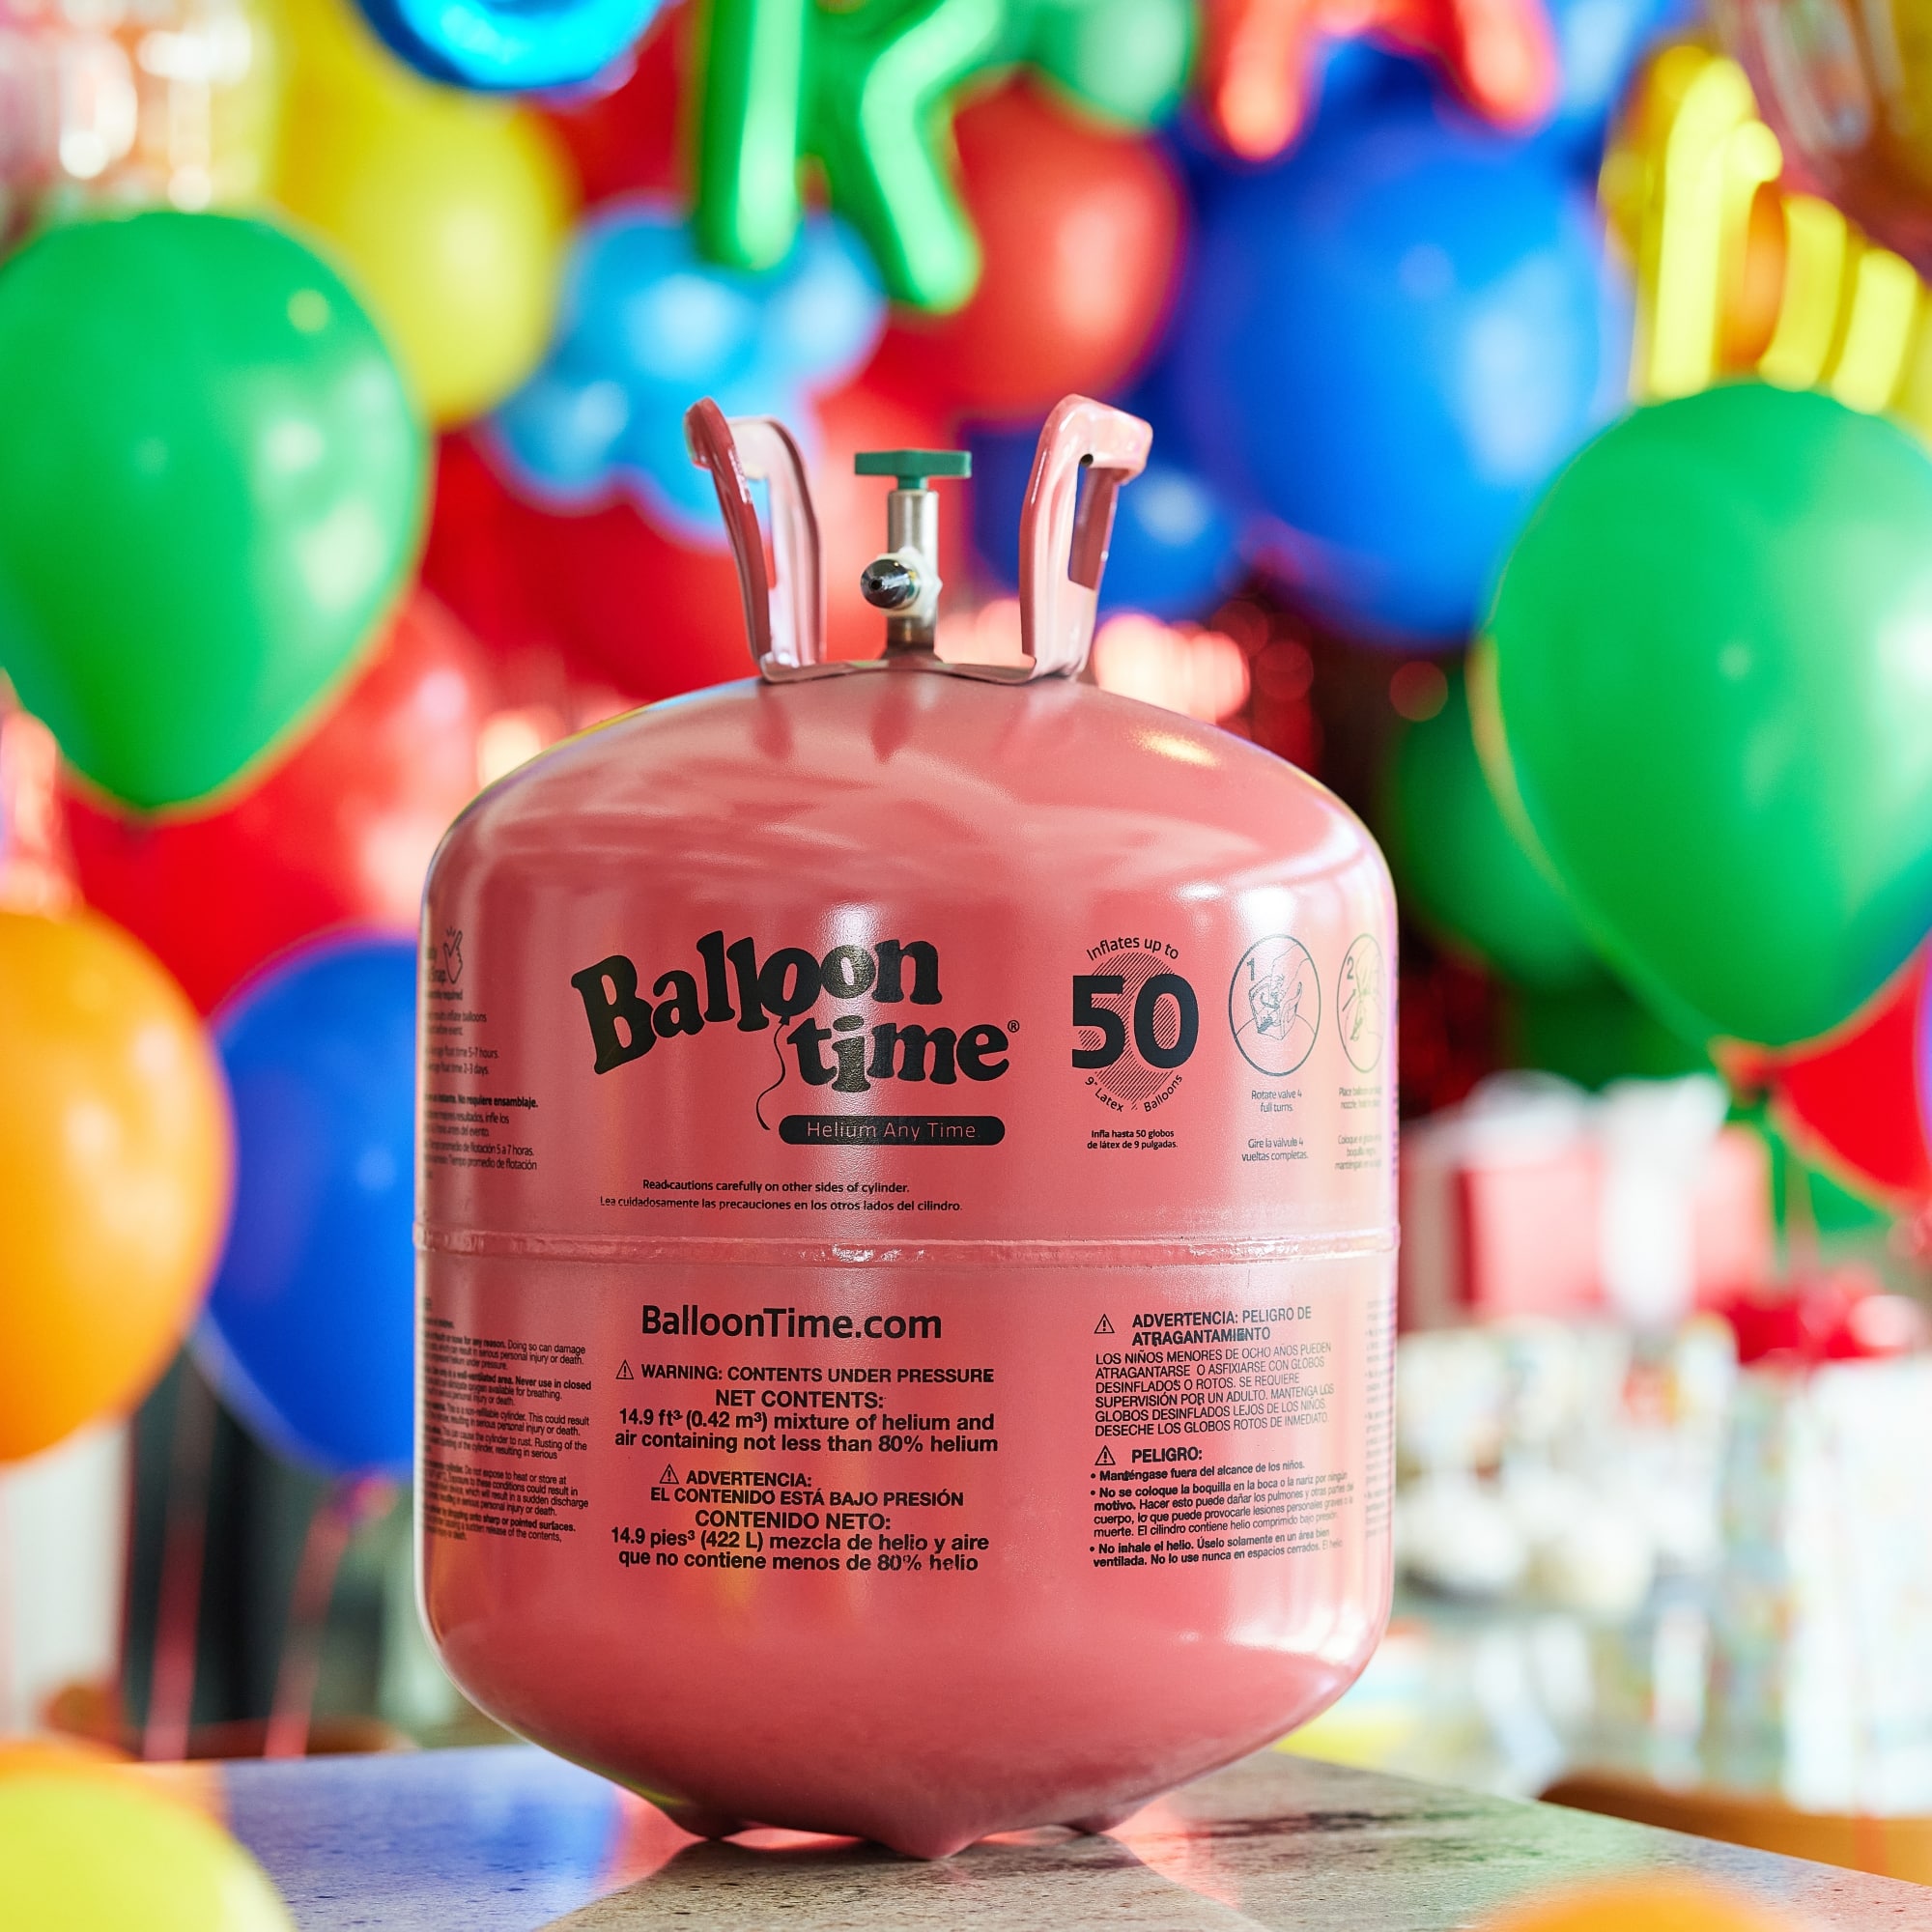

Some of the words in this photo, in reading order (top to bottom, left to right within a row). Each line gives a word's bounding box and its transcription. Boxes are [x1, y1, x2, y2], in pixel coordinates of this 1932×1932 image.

[1086, 937, 1140, 961] Inflates
[1144, 938, 1162, 952] up
[1164, 944, 1179, 959] to
[571, 930, 943, 1075] Balloon
[1071, 974, 1200, 1070] 50
[1094, 1088, 1123, 1112] Latex
[1144, 1074, 1182, 1112] Balloons
[1252, 1091, 1276, 1099] Rotate
[1278, 1090, 1296, 1098] valve
[808, 1122, 876, 1137] Helium
[884, 1122, 920, 1141] Any
[1092, 1129, 1110, 1138] Infla
[1112, 1129, 1134, 1138] hasta
[1136, 1129, 1147, 1138] 50
[1149, 1129, 1175, 1139] globos
[1099, 1140, 1121, 1149] látex
[1122, 1140, 1132, 1149] de
[1134, 1140, 1140, 1149] 9
[1141, 1140, 1178, 1150] pulgadas.
[716, 1181, 763, 1194] carefully
[764, 1183, 780, 1192] on
[781, 1181, 813, 1192] other
[815, 1182, 843, 1192] sides
[846, 1182, 859, 1192] of
[862, 1182, 910, 1194] cylinder.
[600, 1196, 615, 1206] Lea
[617, 1196, 699, 1208] cuidadosamente
[701, 1198, 716, 1208] las
[719, 1199, 791, 1210] precauciones
[810, 1199, 827, 1209] los
[830, 1202, 860, 1210] otros
[863, 1200, 894, 1210] lados
[896, 1200, 914, 1210] del
[917, 1200, 962, 1210] cilindro.
[642, 1304, 941, 1339] BalloonTime.com
[1132, 1311, 1237, 1327] ADVERTENCIA:
[1242, 1307, 1293, 1322] PELIGRO
[1297, 1306, 1311, 1320] DE
[1131, 1326, 1270, 1347] ATRAGANTAMIENTO
[1095, 1352, 1122, 1364] LOS
[1124, 1350, 1163, 1364] NIÑOS
[1167, 1349, 1222, 1362] MENORES
[1225, 1348, 1238, 1359] DE
[1241, 1347, 1270, 1358] OCHO
[640, 1363, 722, 1379] WARNING:
[727, 1366, 822, 1382] CONTENTS
[828, 1368, 891, 1382] UNDER
[897, 1368, 994, 1382] PRESSURE
[1095, 1379, 1180, 1393] DESINFLADOS
[1183, 1378, 1192, 1390] O
[1196, 1377, 1236, 1389] ROTOS.
[1239, 1376, 1252, 1387] SE
[1255, 1372, 1299, 1386] REQUIERE
[716, 1389, 755, 1406] NET
[761, 1390, 886, 1408] CONTENTS:
[619, 1407, 653, 1425] 14.9
[686, 1409, 729, 1431] (0.42
[774, 1412, 849, 1430] mixture
[856, 1413, 877, 1430] of
[882, 1413, 950, 1431] helium
[956, 1413, 994, 1430] and
[614, 1430, 637, 1446] air
[641, 1432, 737, 1453] containing
[744, 1435, 776, 1450] not
[781, 1434, 821, 1451] less
[827, 1435, 871, 1451] than
[878, 1435, 923, 1452] 80%
[930, 1435, 998, 1452] helium
[1131, 1446, 1202, 1463] PELIGRO:
[686, 1469, 811, 1487] ADVERTENCIA:
[1170, 1467, 1197, 1478] fuera
[1199, 1465, 1214, 1476] del
[1217, 1464, 1253, 1475] alcance
[1255, 1463, 1266, 1473] de
[1268, 1462, 1280, 1471] los
[1282, 1460, 1305, 1470] niños.
[650, 1487, 669, 1501] EL
[674, 1487, 775, 1505] CONTENIDO
[781, 1488, 825, 1505] ESTÁ
[830, 1492, 878, 1506] BAJO
[883, 1488, 963, 1506] PRESIÓN
[695, 1509, 819, 1529] CONTENIDO
[826, 1513, 891, 1530] NETO:
[611, 1526, 645, 1544] 14.9
[700, 1529, 739, 1549] (422
[746, 1531, 763, 1550] L)
[769, 1533, 840, 1549] mezcla
[847, 1533, 872, 1550] de
[879, 1533, 927, 1550] helio
[933, 1538, 946, 1553] y
[952, 1533, 989, 1550] aire
[1098, 1543, 1115, 1553] No
[1153, 1540, 1163, 1551] el
[1166, 1539, 1194, 1550] helio.
[1197, 1536, 1224, 1548] Úselo
[1227, 1534, 1273, 1547] solamente
[1275, 1534, 1285, 1543] en
[1287, 1533, 1296, 1542] un
[618, 1550, 650, 1567] que
[656, 1552, 678, 1566] no
[684, 1550, 766, 1569] contiene
[773, 1556, 839, 1570] menos
[846, 1553, 871, 1571] de
[929, 1553, 978, 1571] helio
